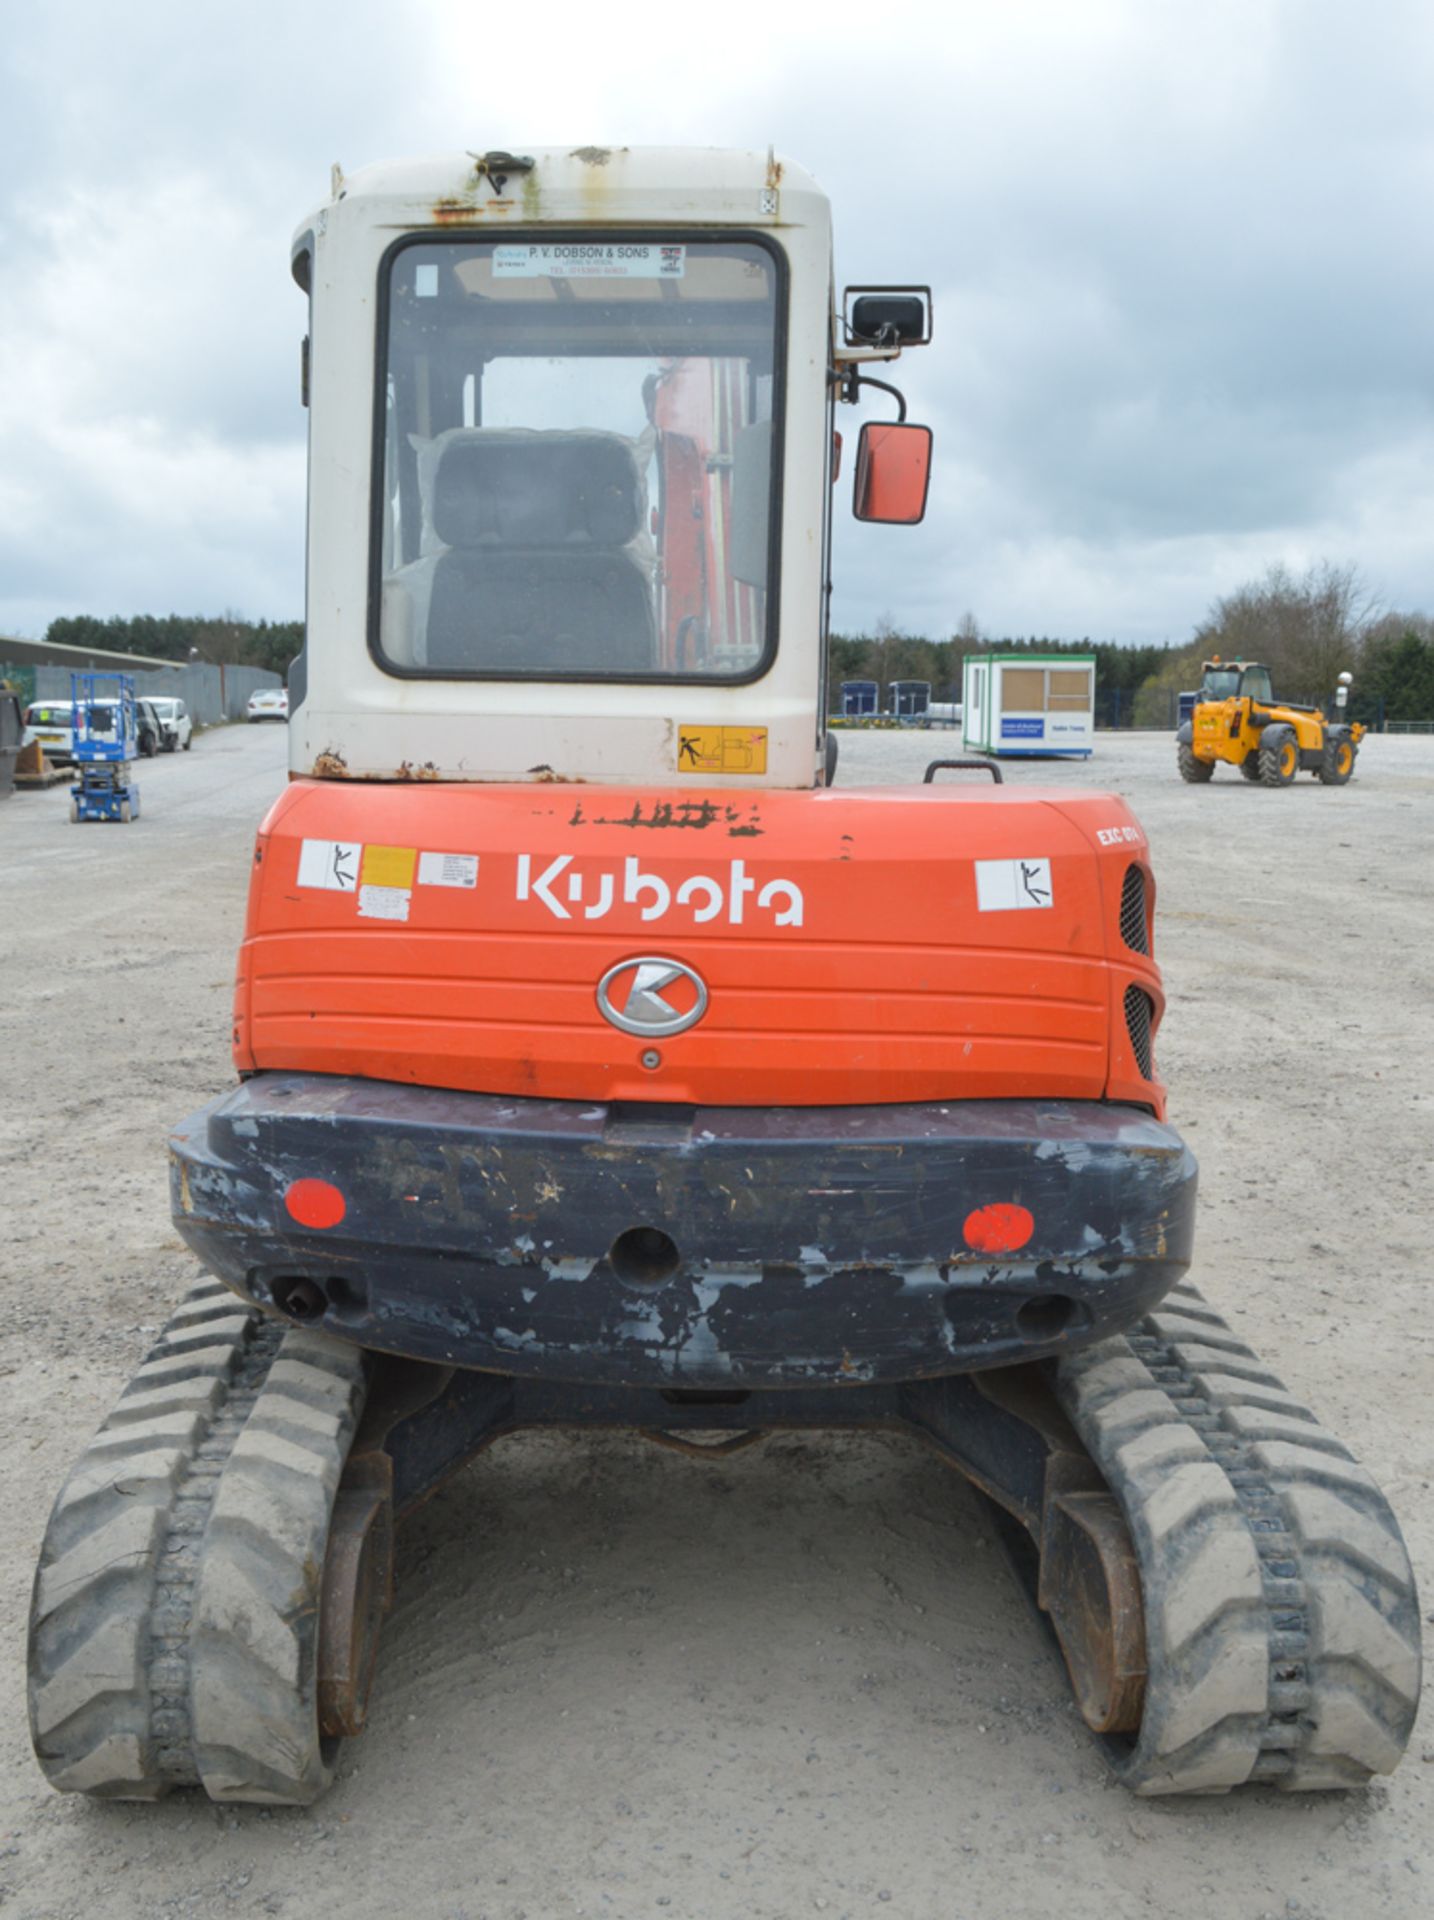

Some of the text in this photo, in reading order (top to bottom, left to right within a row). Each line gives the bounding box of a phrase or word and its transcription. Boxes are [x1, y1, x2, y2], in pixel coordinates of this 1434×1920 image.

[529, 247, 650, 258] P. V. DOBSON & SONS
[1096, 827, 1123, 846] EXC
[516, 854, 804, 927] Kubota
